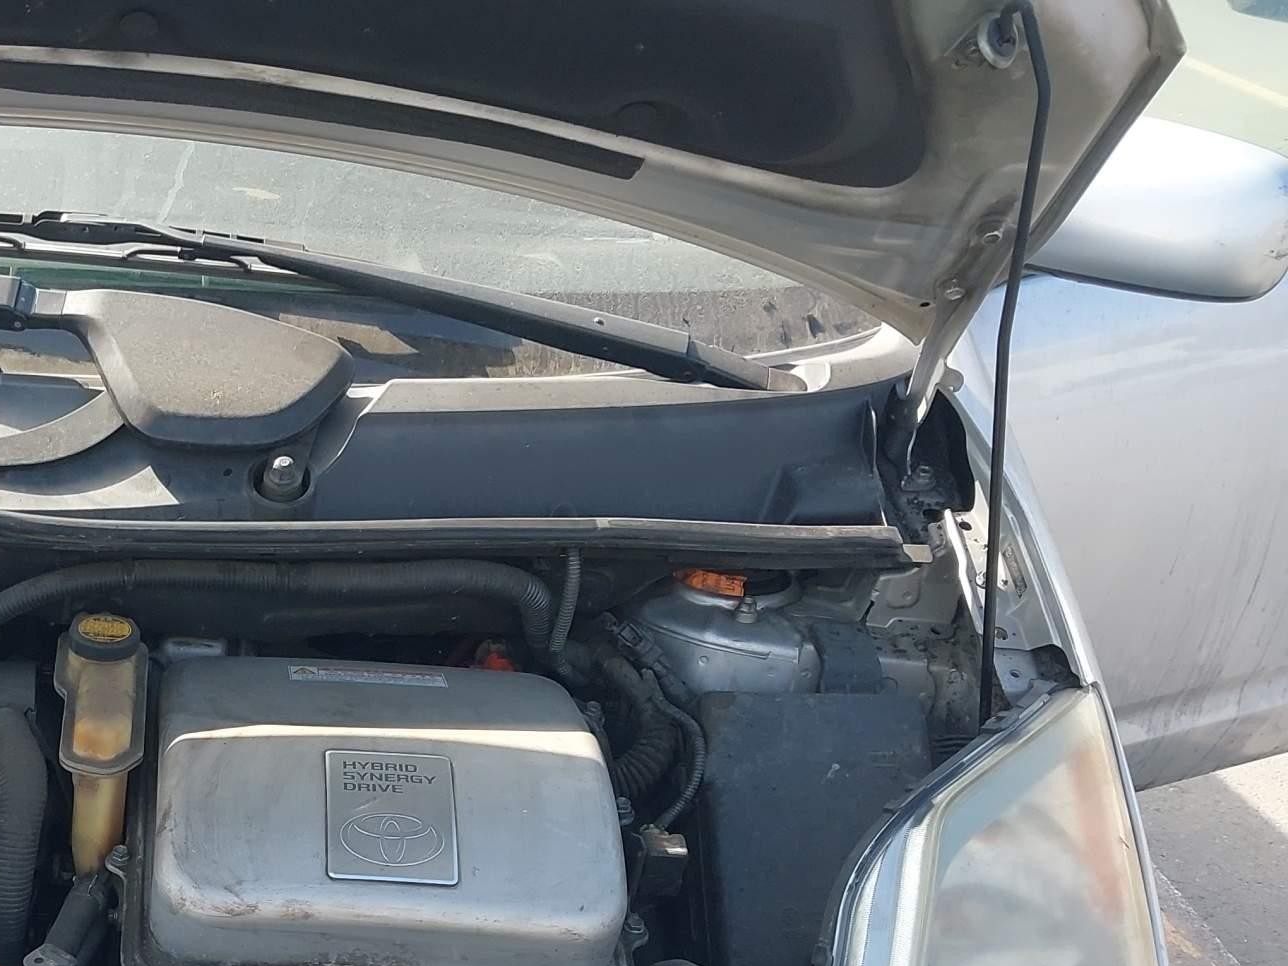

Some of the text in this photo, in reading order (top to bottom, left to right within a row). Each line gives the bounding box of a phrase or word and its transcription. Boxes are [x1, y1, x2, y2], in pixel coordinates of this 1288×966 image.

[343, 761, 417, 773] HYBRID
[343, 772, 437, 785] SYNERGY
[343, 783, 404, 793] DRIVE
